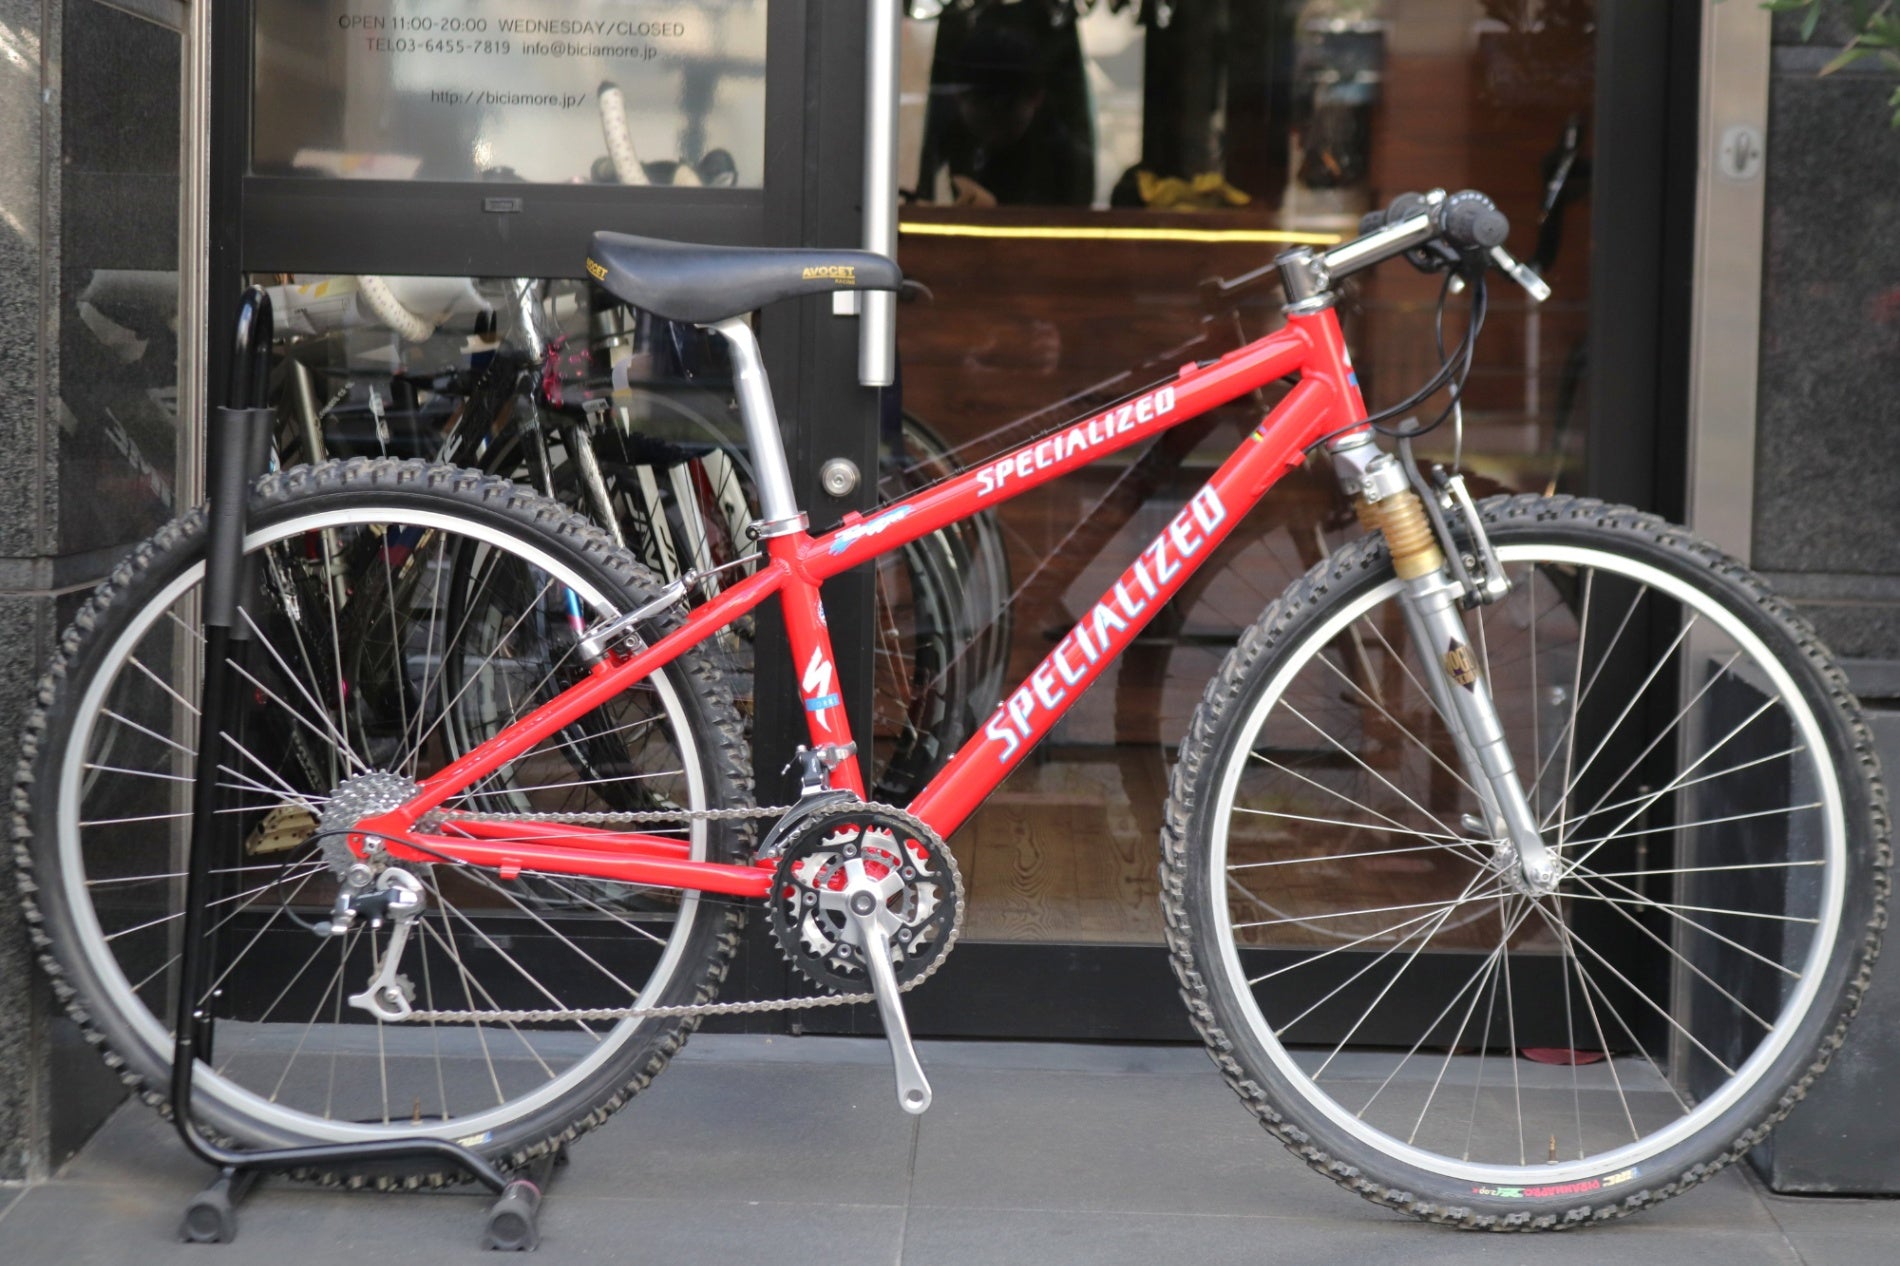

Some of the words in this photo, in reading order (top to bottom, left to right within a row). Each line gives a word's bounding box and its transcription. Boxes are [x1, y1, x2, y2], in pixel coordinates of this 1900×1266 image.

[338, 15, 385, 29] OPEN
[392, 16, 487, 32] 11:00-20:00
[498, 18, 685, 37] WEDNESDAY/CLOSED
[522, 40, 658, 60] info@biciamore.jp
[431, 88, 586, 109] http://biciamore.jp/
[802, 265, 855, 277] AVOCET
[975, 386, 1176, 497] SPECIALIZED
[985, 482, 1228, 764] SPECIALIZED
